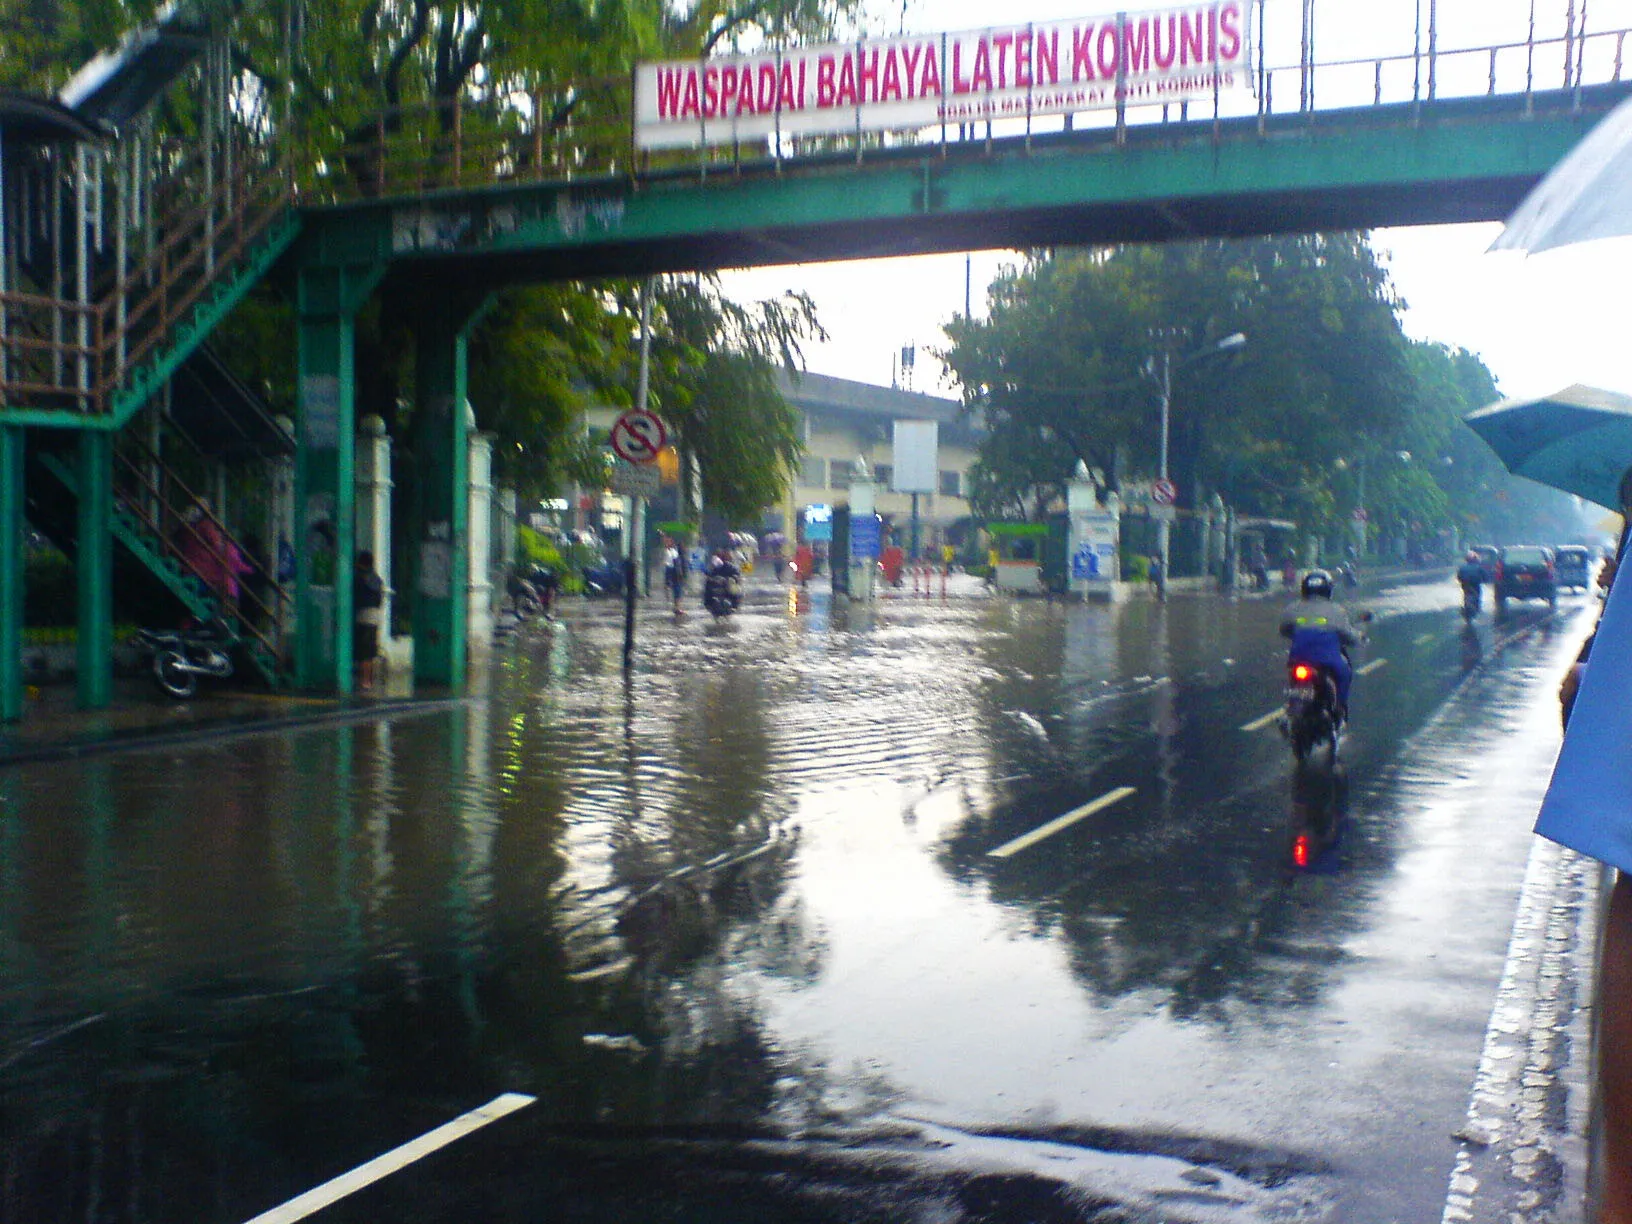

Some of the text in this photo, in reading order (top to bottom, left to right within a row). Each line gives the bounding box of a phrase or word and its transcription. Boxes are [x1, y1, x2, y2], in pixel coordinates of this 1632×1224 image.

[657, 3, 1241, 120] WASPADAI BAHAYA LATEN KOMUNIS
